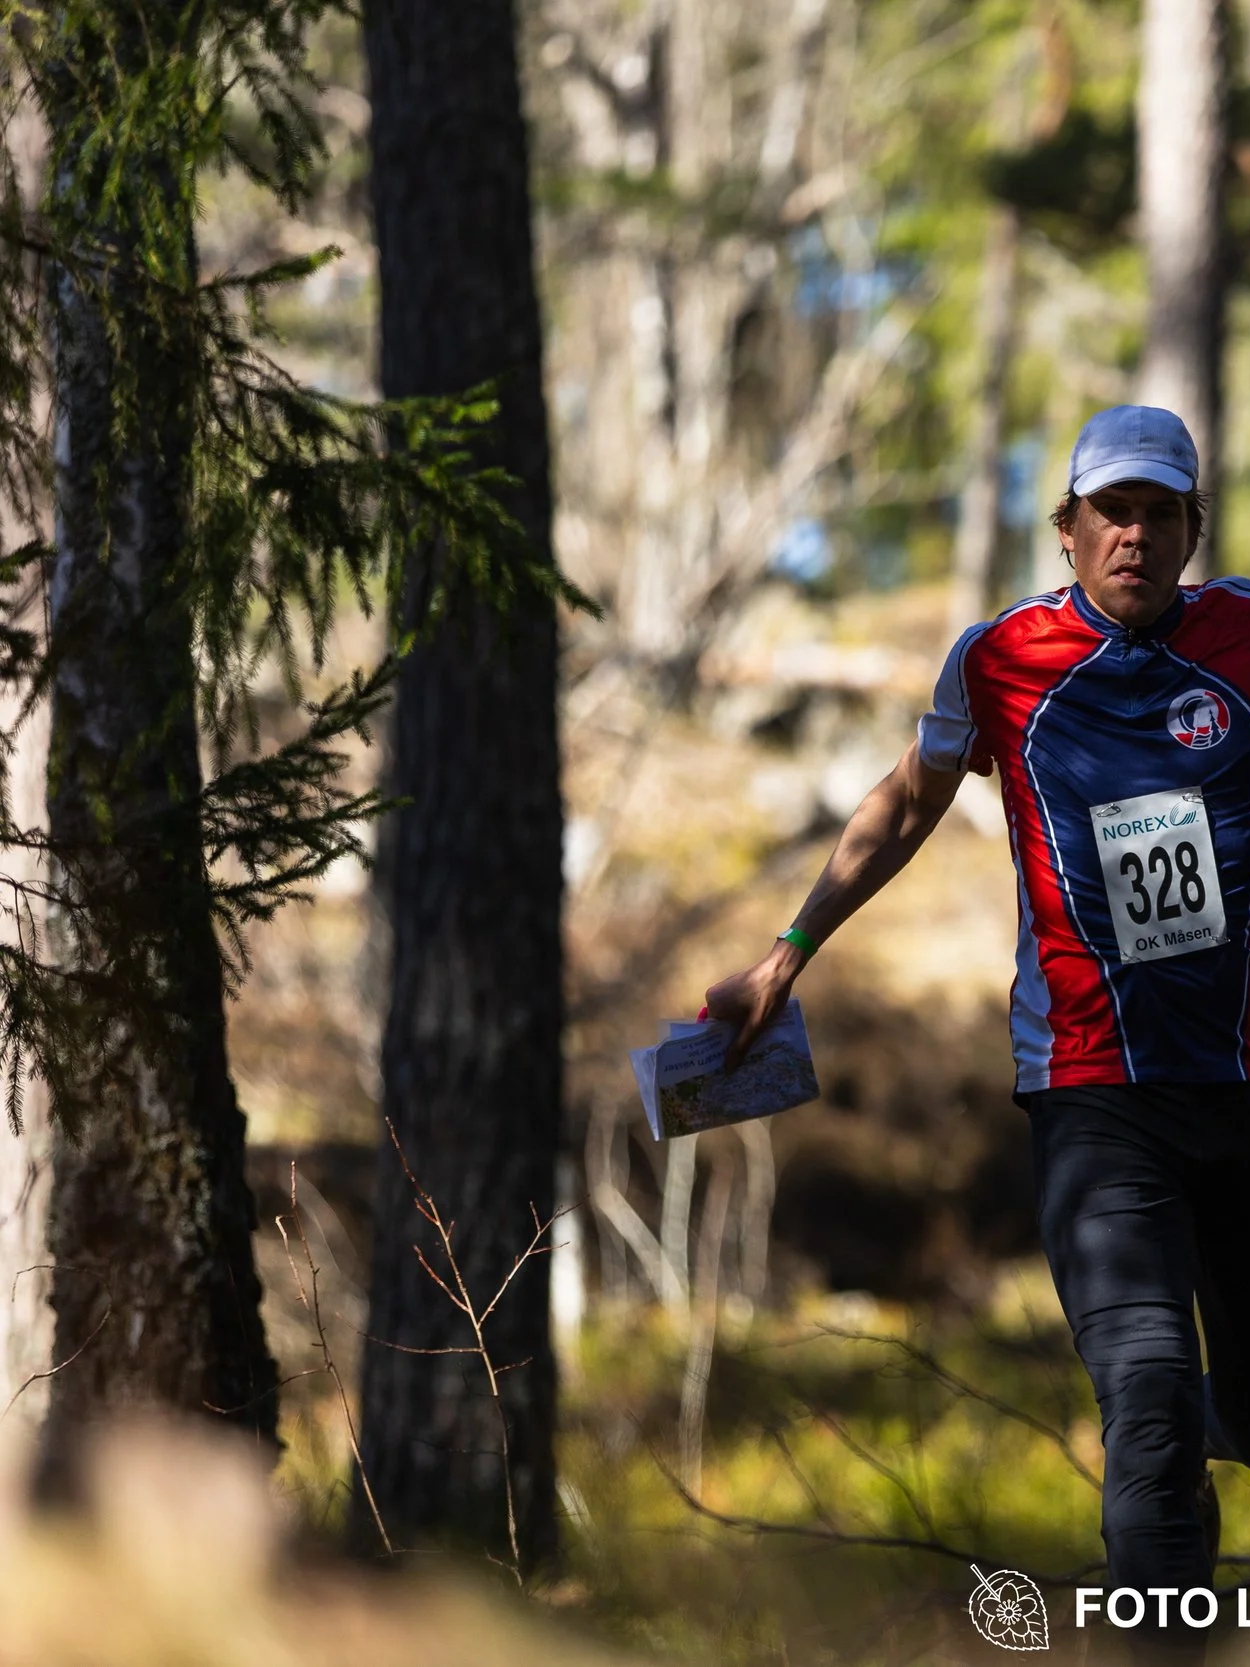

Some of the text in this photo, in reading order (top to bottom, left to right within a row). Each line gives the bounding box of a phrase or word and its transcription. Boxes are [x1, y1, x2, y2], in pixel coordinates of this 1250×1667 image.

[1102, 815, 1169, 841] NOREX
[1119, 841, 1206, 925] 328
[1135, 927, 1212, 951] OK Måsen
